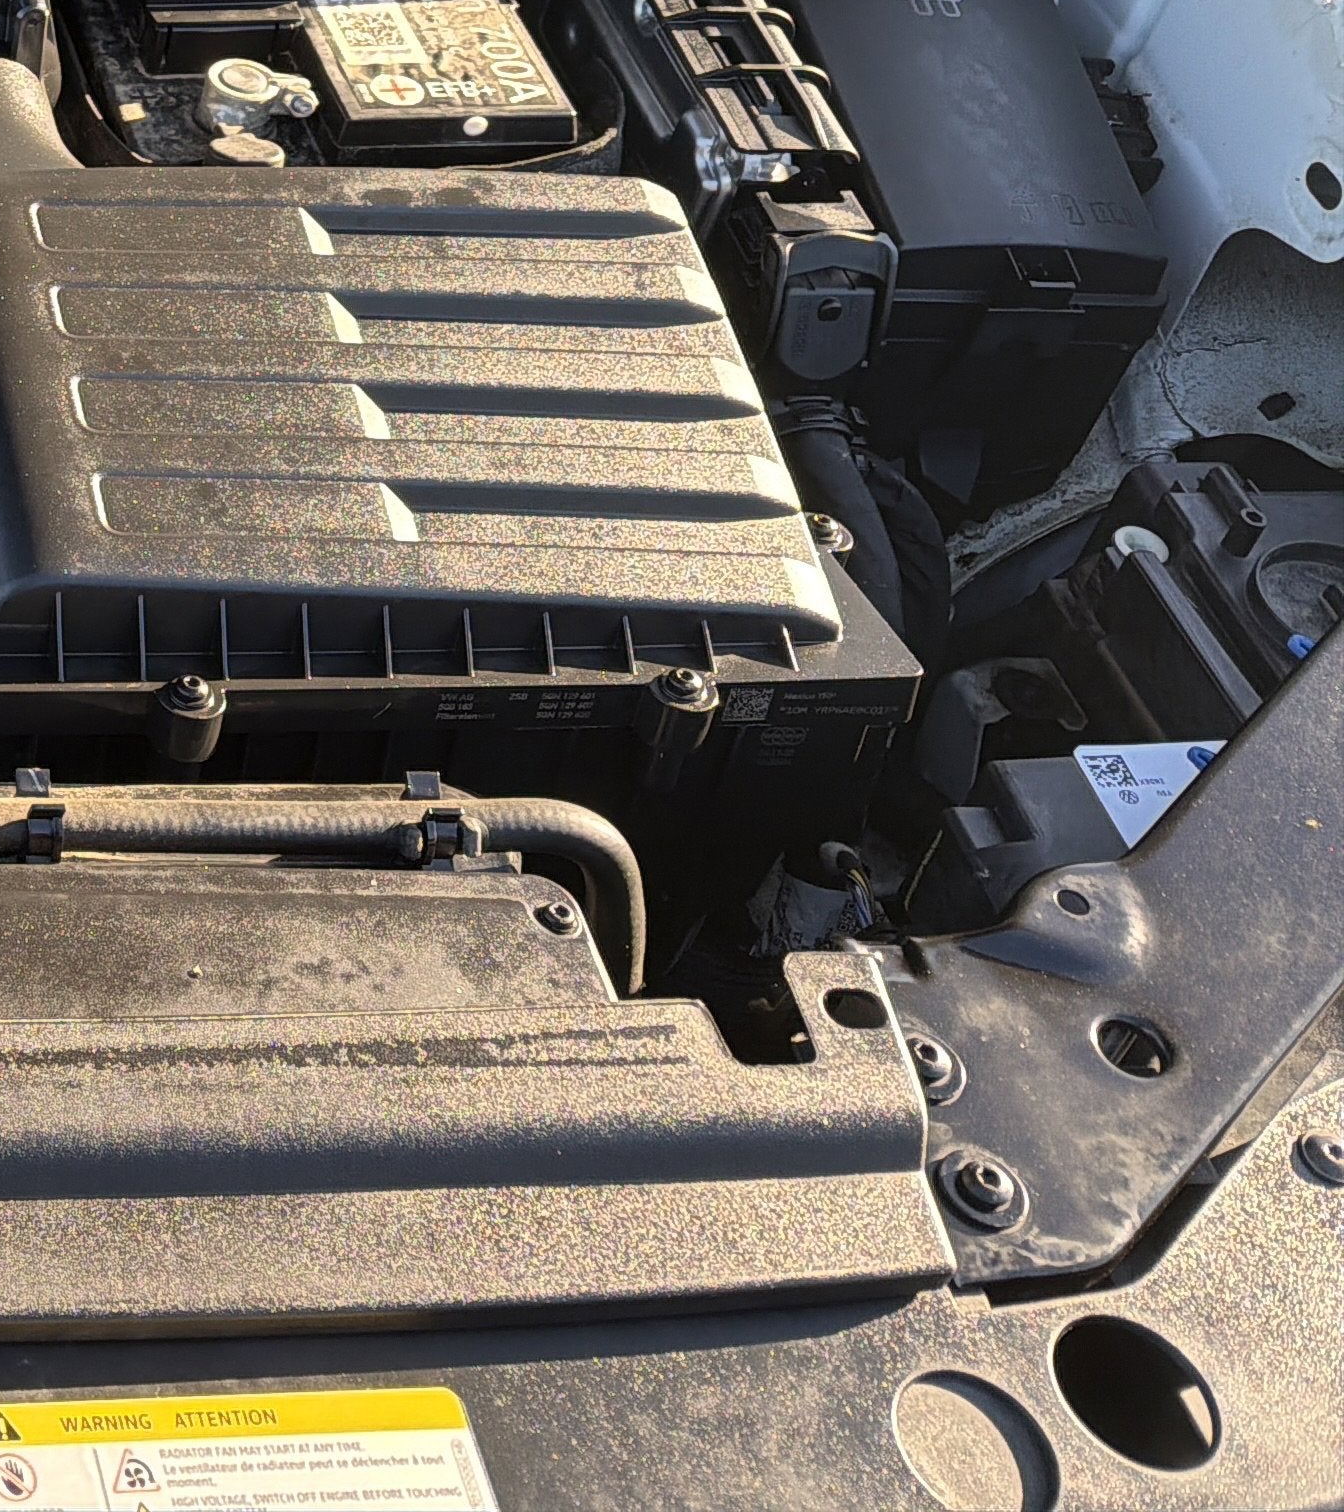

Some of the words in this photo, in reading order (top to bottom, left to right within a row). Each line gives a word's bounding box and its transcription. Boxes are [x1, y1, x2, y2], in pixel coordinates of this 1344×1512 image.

[469, 23, 548, 104] 700A
[424, 80, 497, 99] EFB+
[59, 1413, 153, 1433] WARNING
[175, 1408, 278, 1429] ATTENTION
[159, 1446, 212, 1459] RADIATOR
[215, 1446, 237, 1458] FAN
[239, 1445, 262, 1457] MAY
[263, 1443, 296, 1456] START
[298, 1442, 310, 1454] AT
[313, 1442, 334, 1453] ANY
[163, 1464, 176, 1476] Le
[179, 1462, 237, 1475] ventilateur
[240, 1461, 254, 1473] de
[257, 1460, 306, 1472] radiateur
[308, 1457, 334, 1472] peut
[337, 1459, 348, 1468] se
[351, 1455, 409, 1469] déclencher
[421, 1454, 445, 1466] tout
[171, 1495, 198, 1508] HIGH
[252, 1492, 295, 1506] SWITCH
[297, 1491, 316, 1504] OFF
[319, 1490, 359, 1504] ENGINE
[363, 1488, 404, 1502] BEFORE
[407, 1487, 462, 1500] TOUCHING
